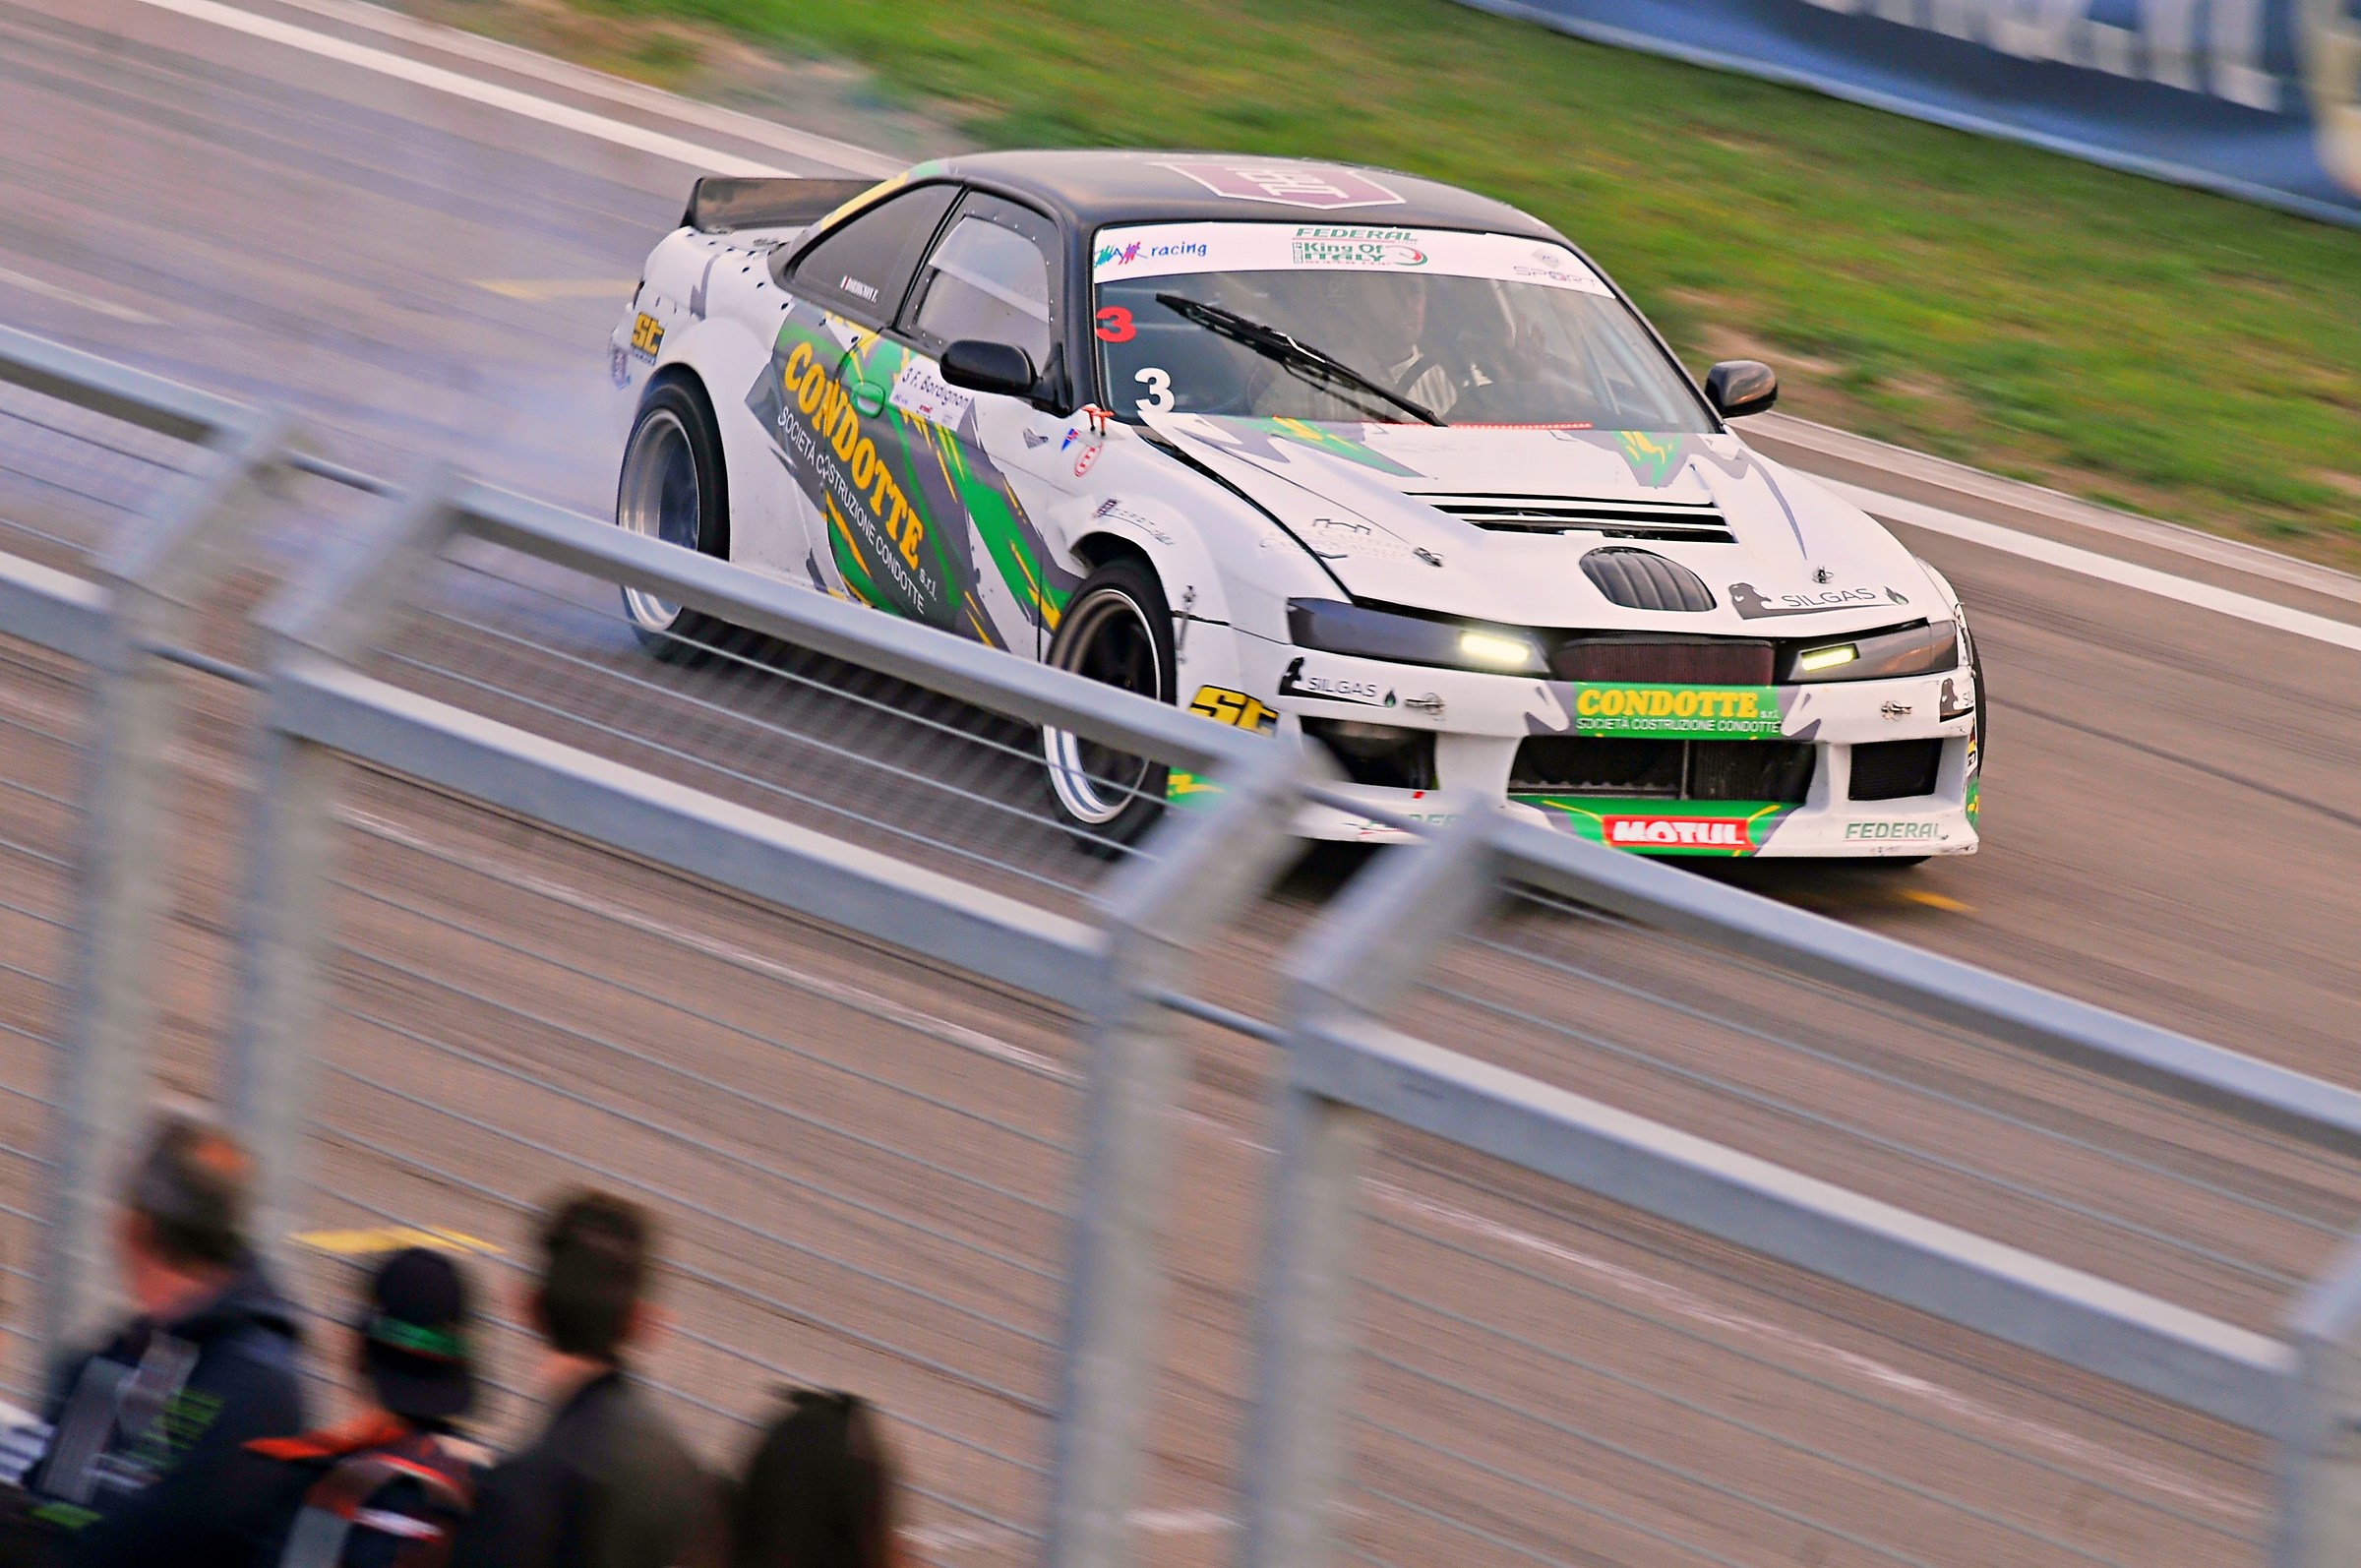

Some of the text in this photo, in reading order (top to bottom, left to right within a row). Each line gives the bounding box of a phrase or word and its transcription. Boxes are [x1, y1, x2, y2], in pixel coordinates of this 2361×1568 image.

[1296, 227, 1419, 241] FEDERAL
[1151, 241, 1207, 258] racing
[1304, 242, 1353, 254] King
[1096, 305, 1137, 343] 3
[1134, 367, 1176, 414] 3
[784, 341, 925, 571] CONDOTTE
[777, 406, 925, 615] SOCIETÀ COSTRUZIONE CONDOTTE
[1782, 587, 1877, 607] SILGAS
[1307, 676, 1377, 697] SILGAS
[1576, 689, 1759, 718] CONDOTTE
[1631, 718, 1716, 732] COSTRUZIONE
[1717, 720, 1782, 734] CONDOTTE
[1612, 820, 1745, 845] MOTUL
[1846, 822, 1943, 839] FEDERAL
